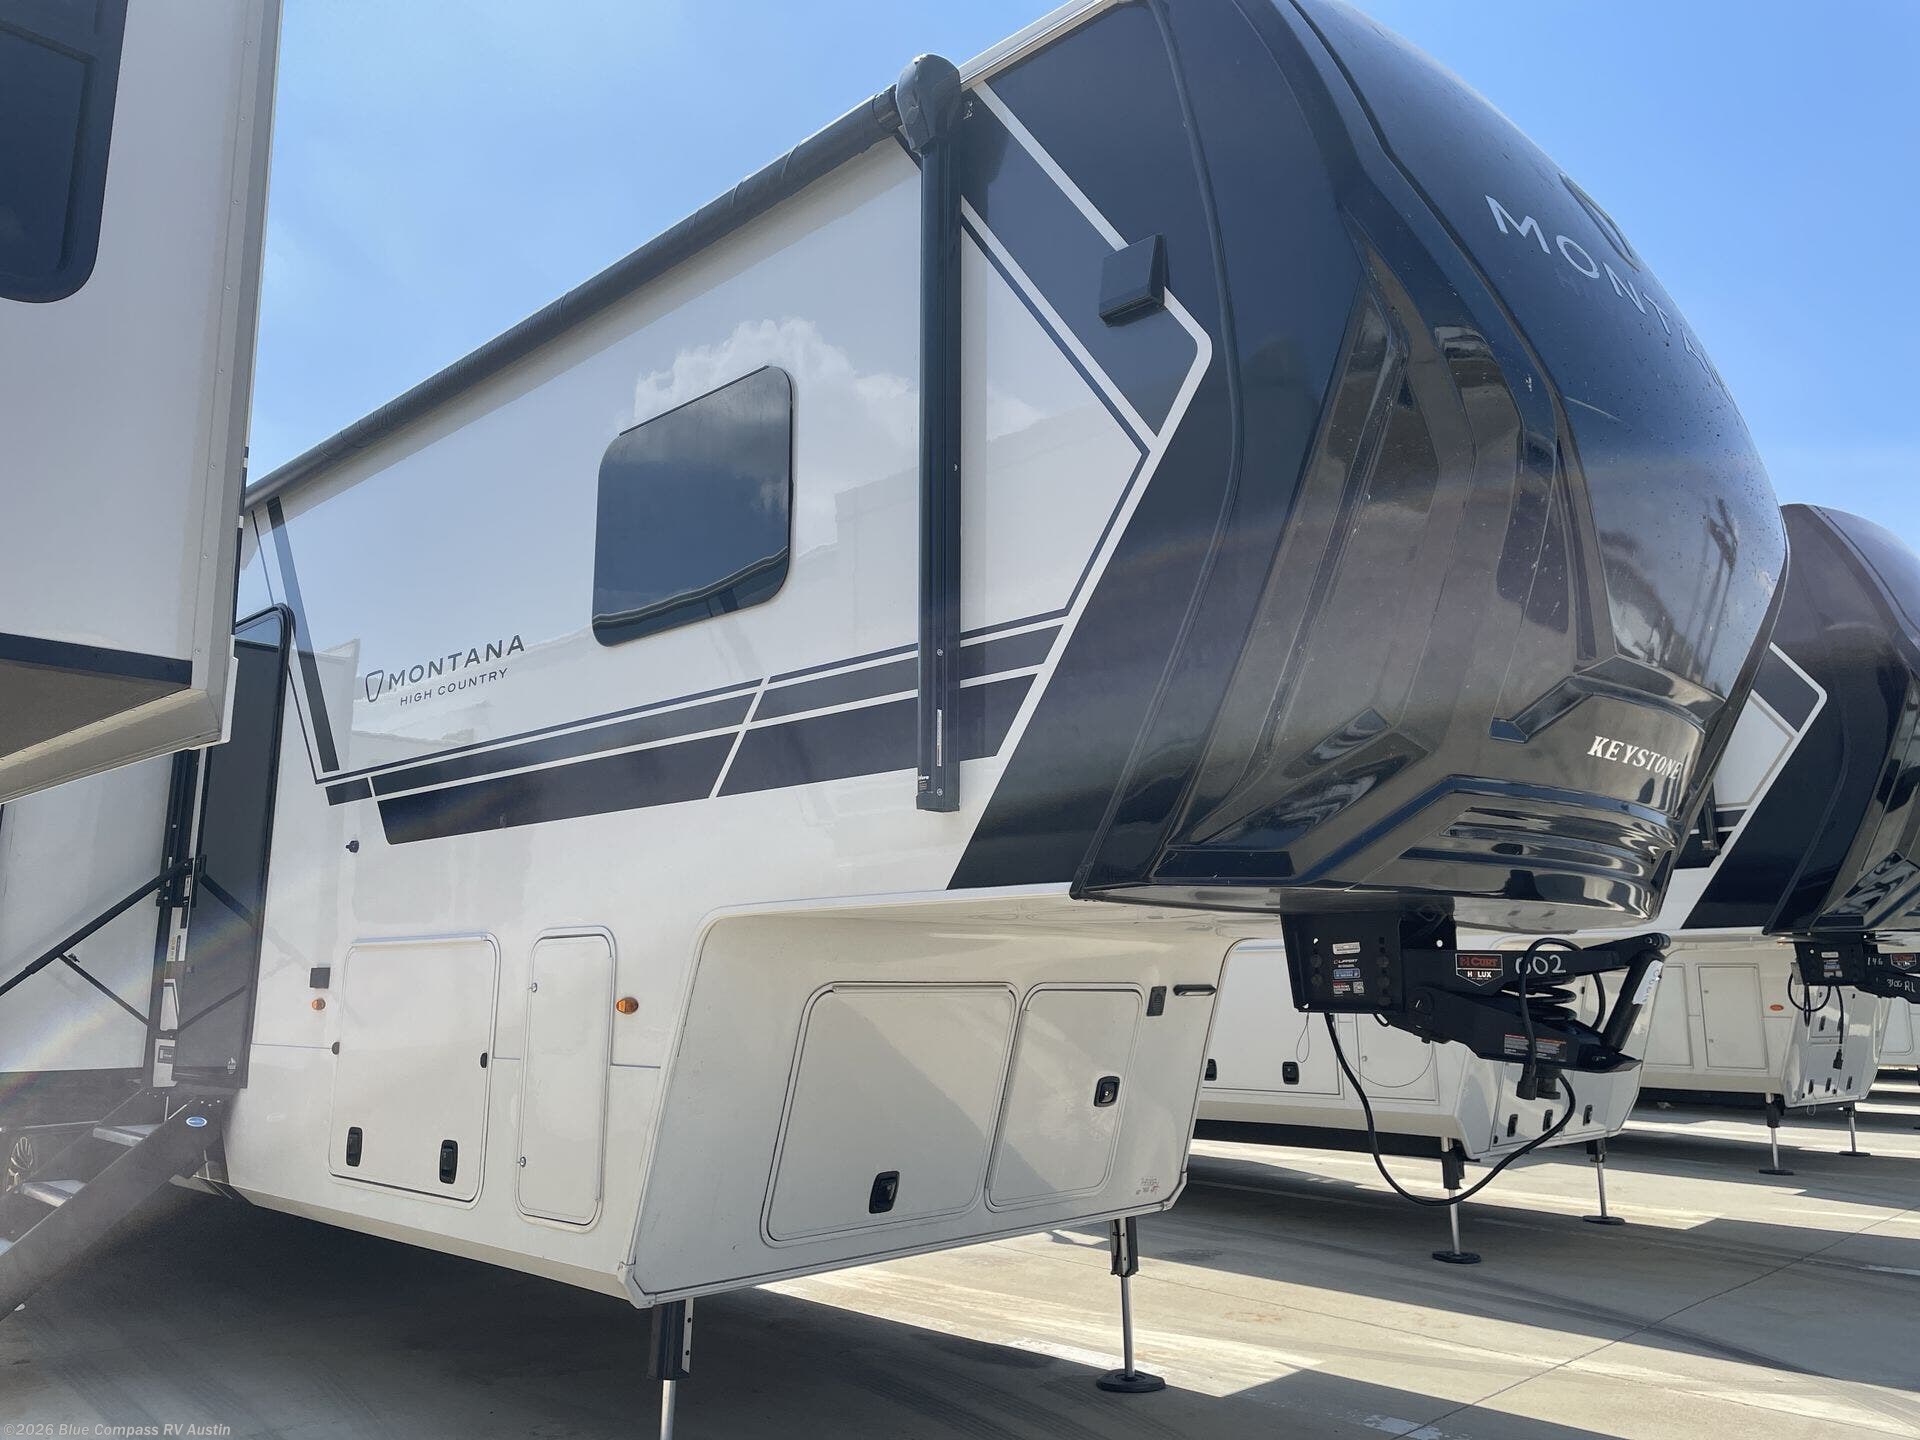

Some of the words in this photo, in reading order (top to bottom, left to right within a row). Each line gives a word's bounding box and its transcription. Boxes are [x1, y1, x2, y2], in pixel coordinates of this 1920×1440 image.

[388, 634, 525, 690] MONTANA
[400, 689, 432, 706] HIGH
[438, 668, 508, 696] COUNTRY
[1586, 735, 1684, 780] KEYSTONE
